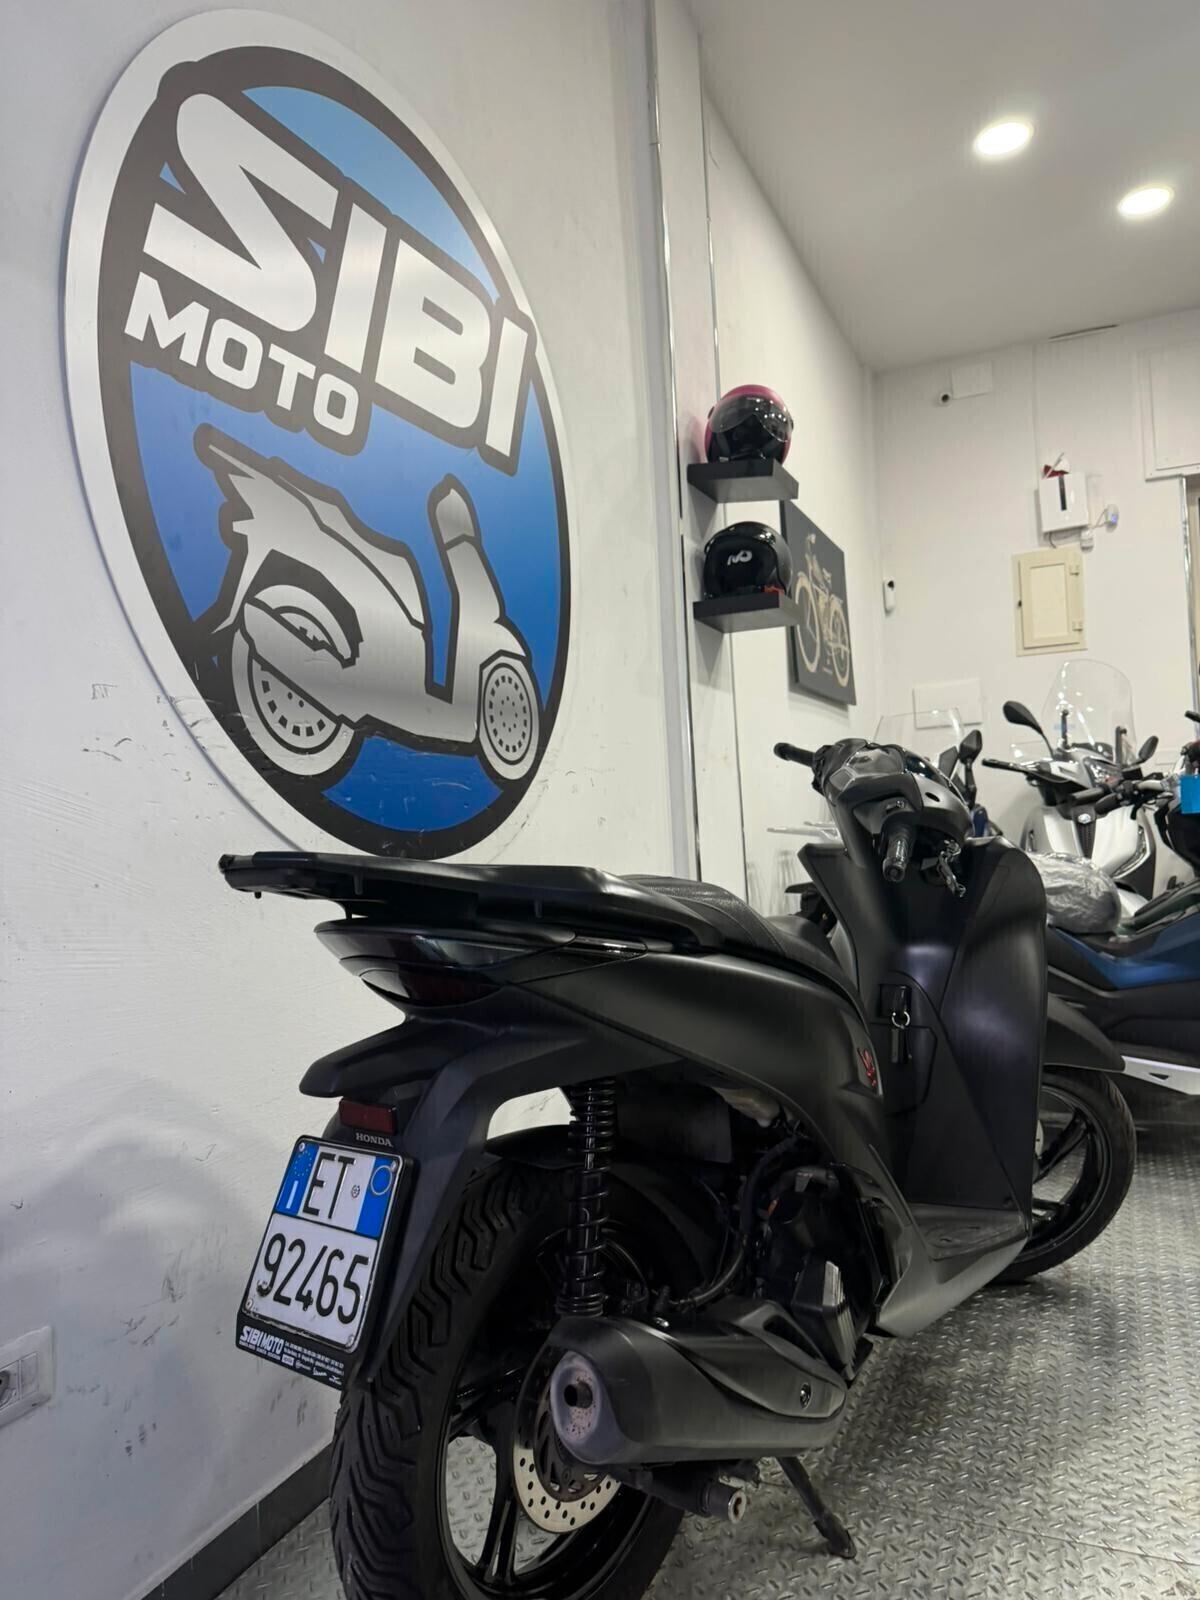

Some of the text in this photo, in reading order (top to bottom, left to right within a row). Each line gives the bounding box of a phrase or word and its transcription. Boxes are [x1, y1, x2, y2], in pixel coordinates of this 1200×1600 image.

[143, 93, 528, 457] SIBI
[124, 271, 360, 436] MOTO
[302, 1151, 355, 1219] ET
[355, 1132, 394, 1148] HONDA
[256, 1232, 369, 1325] 92465
